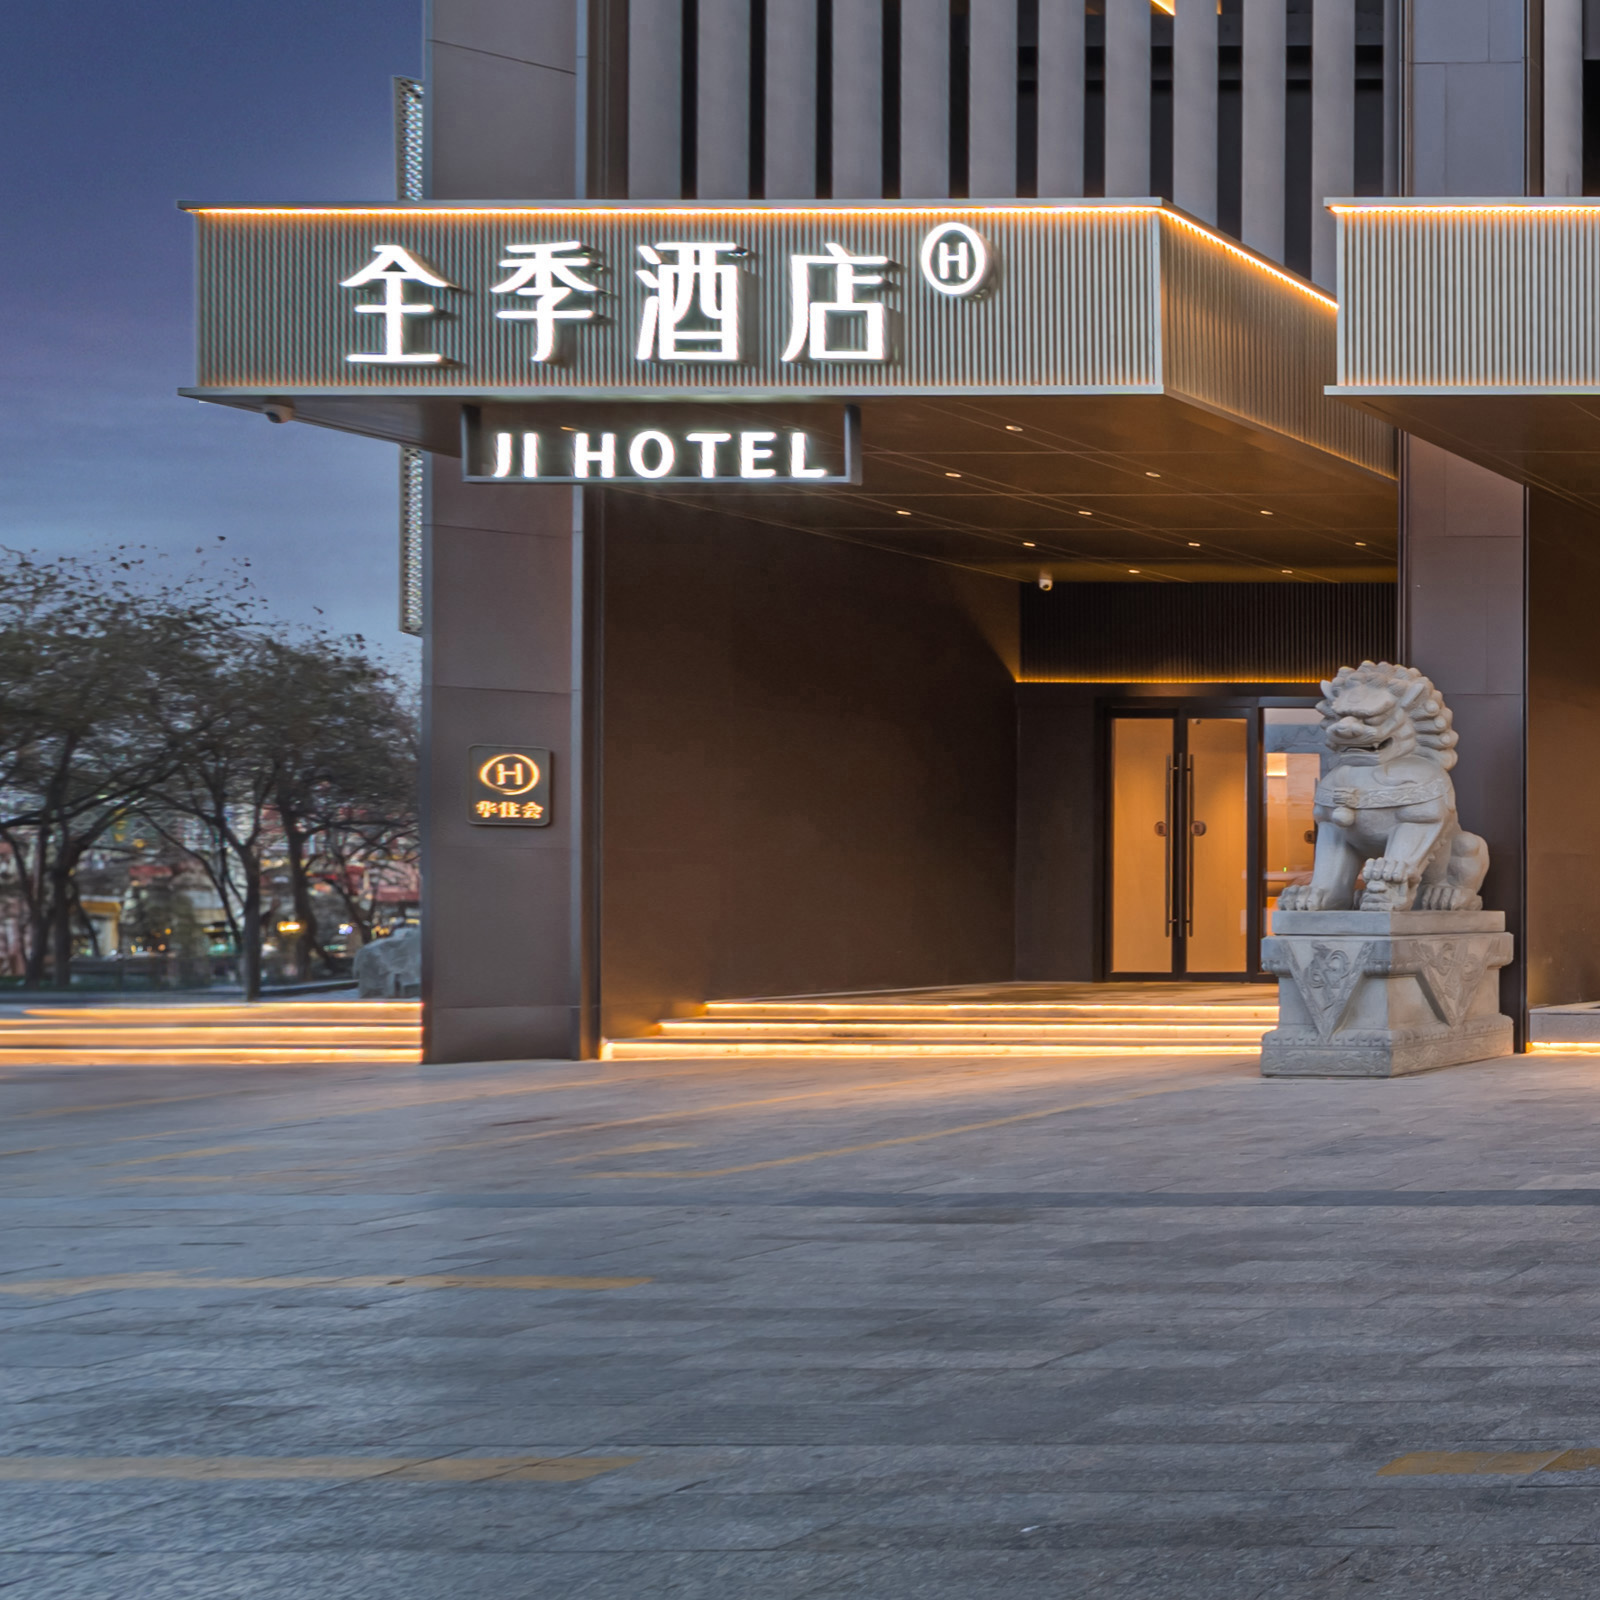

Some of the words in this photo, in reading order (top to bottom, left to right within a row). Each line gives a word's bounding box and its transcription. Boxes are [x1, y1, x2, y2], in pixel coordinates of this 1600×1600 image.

[341, 241, 888, 363] 全季酒店
[493, 432, 538, 479] JI
[573, 430, 827, 479] HOTEL
[475, 800, 544, 820] 华住会
